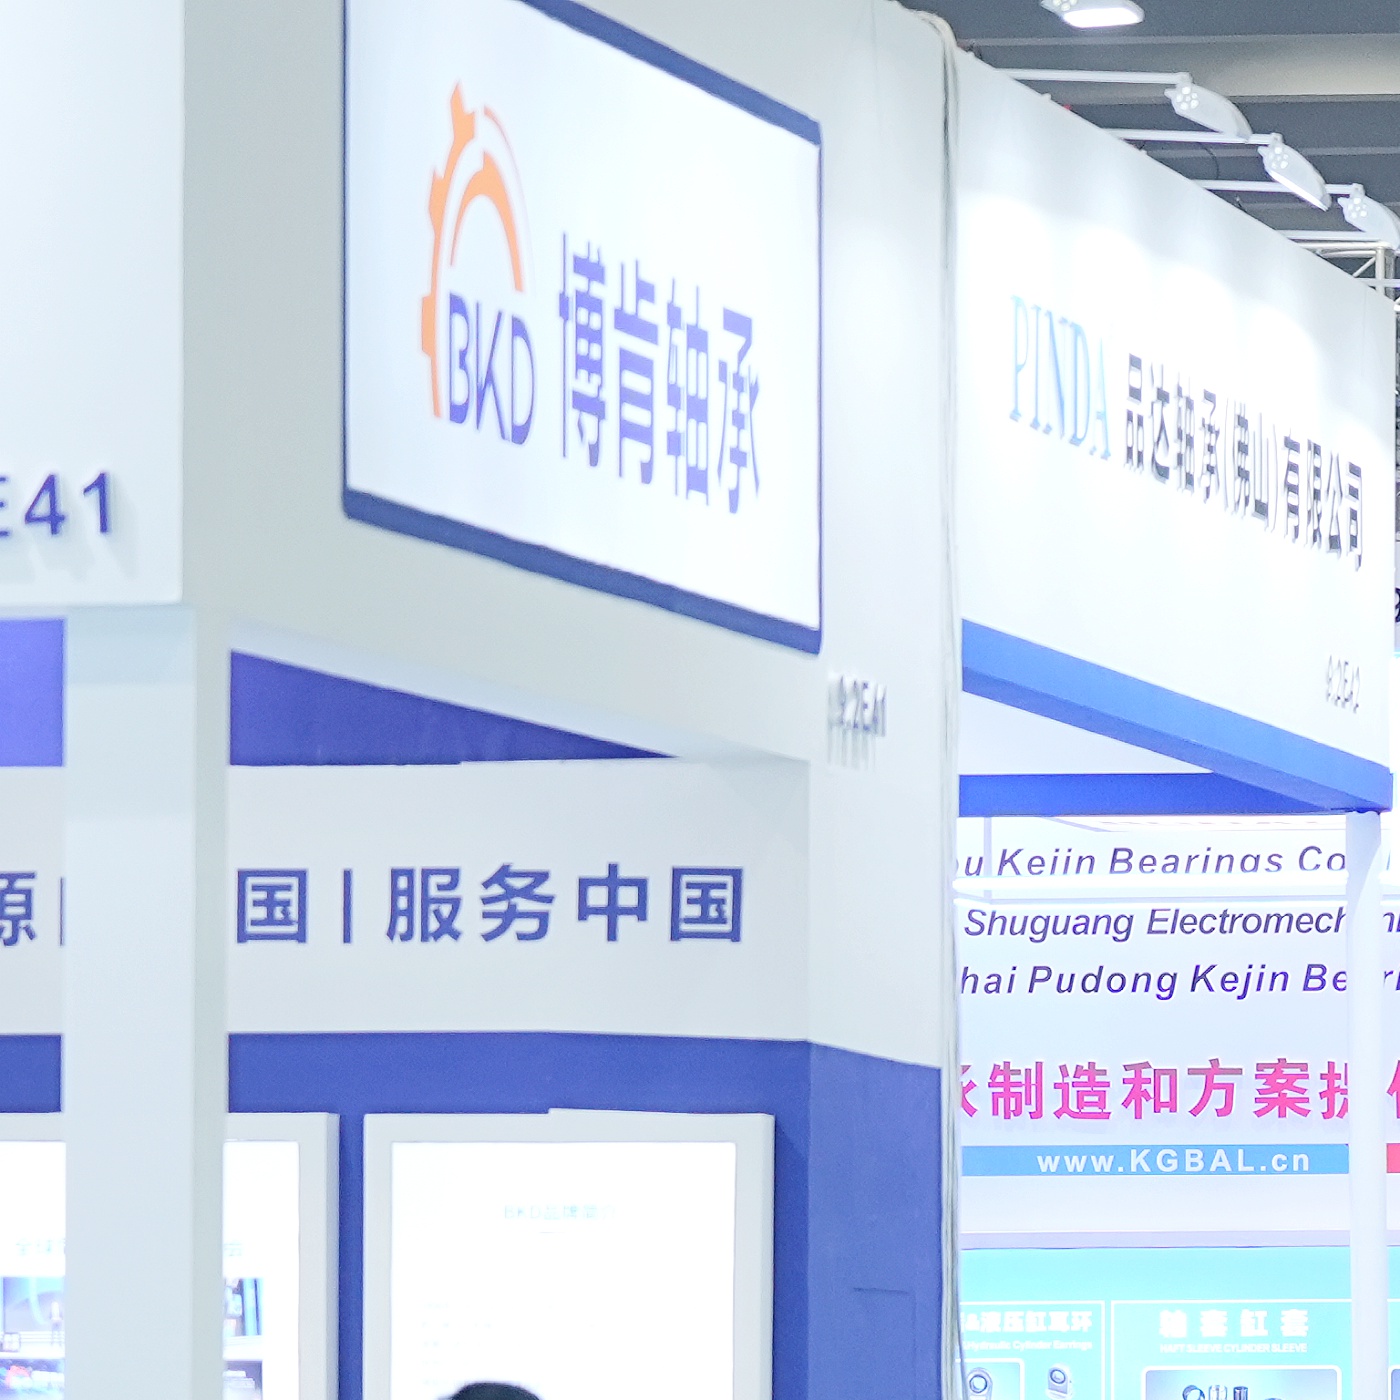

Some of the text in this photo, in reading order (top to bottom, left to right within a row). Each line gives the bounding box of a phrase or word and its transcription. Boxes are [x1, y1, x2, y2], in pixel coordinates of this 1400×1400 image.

[448, 291, 537, 447] BKD
[557, 230, 761, 515] 博肯轴承
[1009, 295, 1111, 461] PINDA
[964, 908, 1135, 943] Shuguang
[1027, 965, 1178, 1000] Pudong
[1189, 963, 1291, 1000] Kejin
[1035, 1147, 1311, 1174] www.KGBAL.cn
